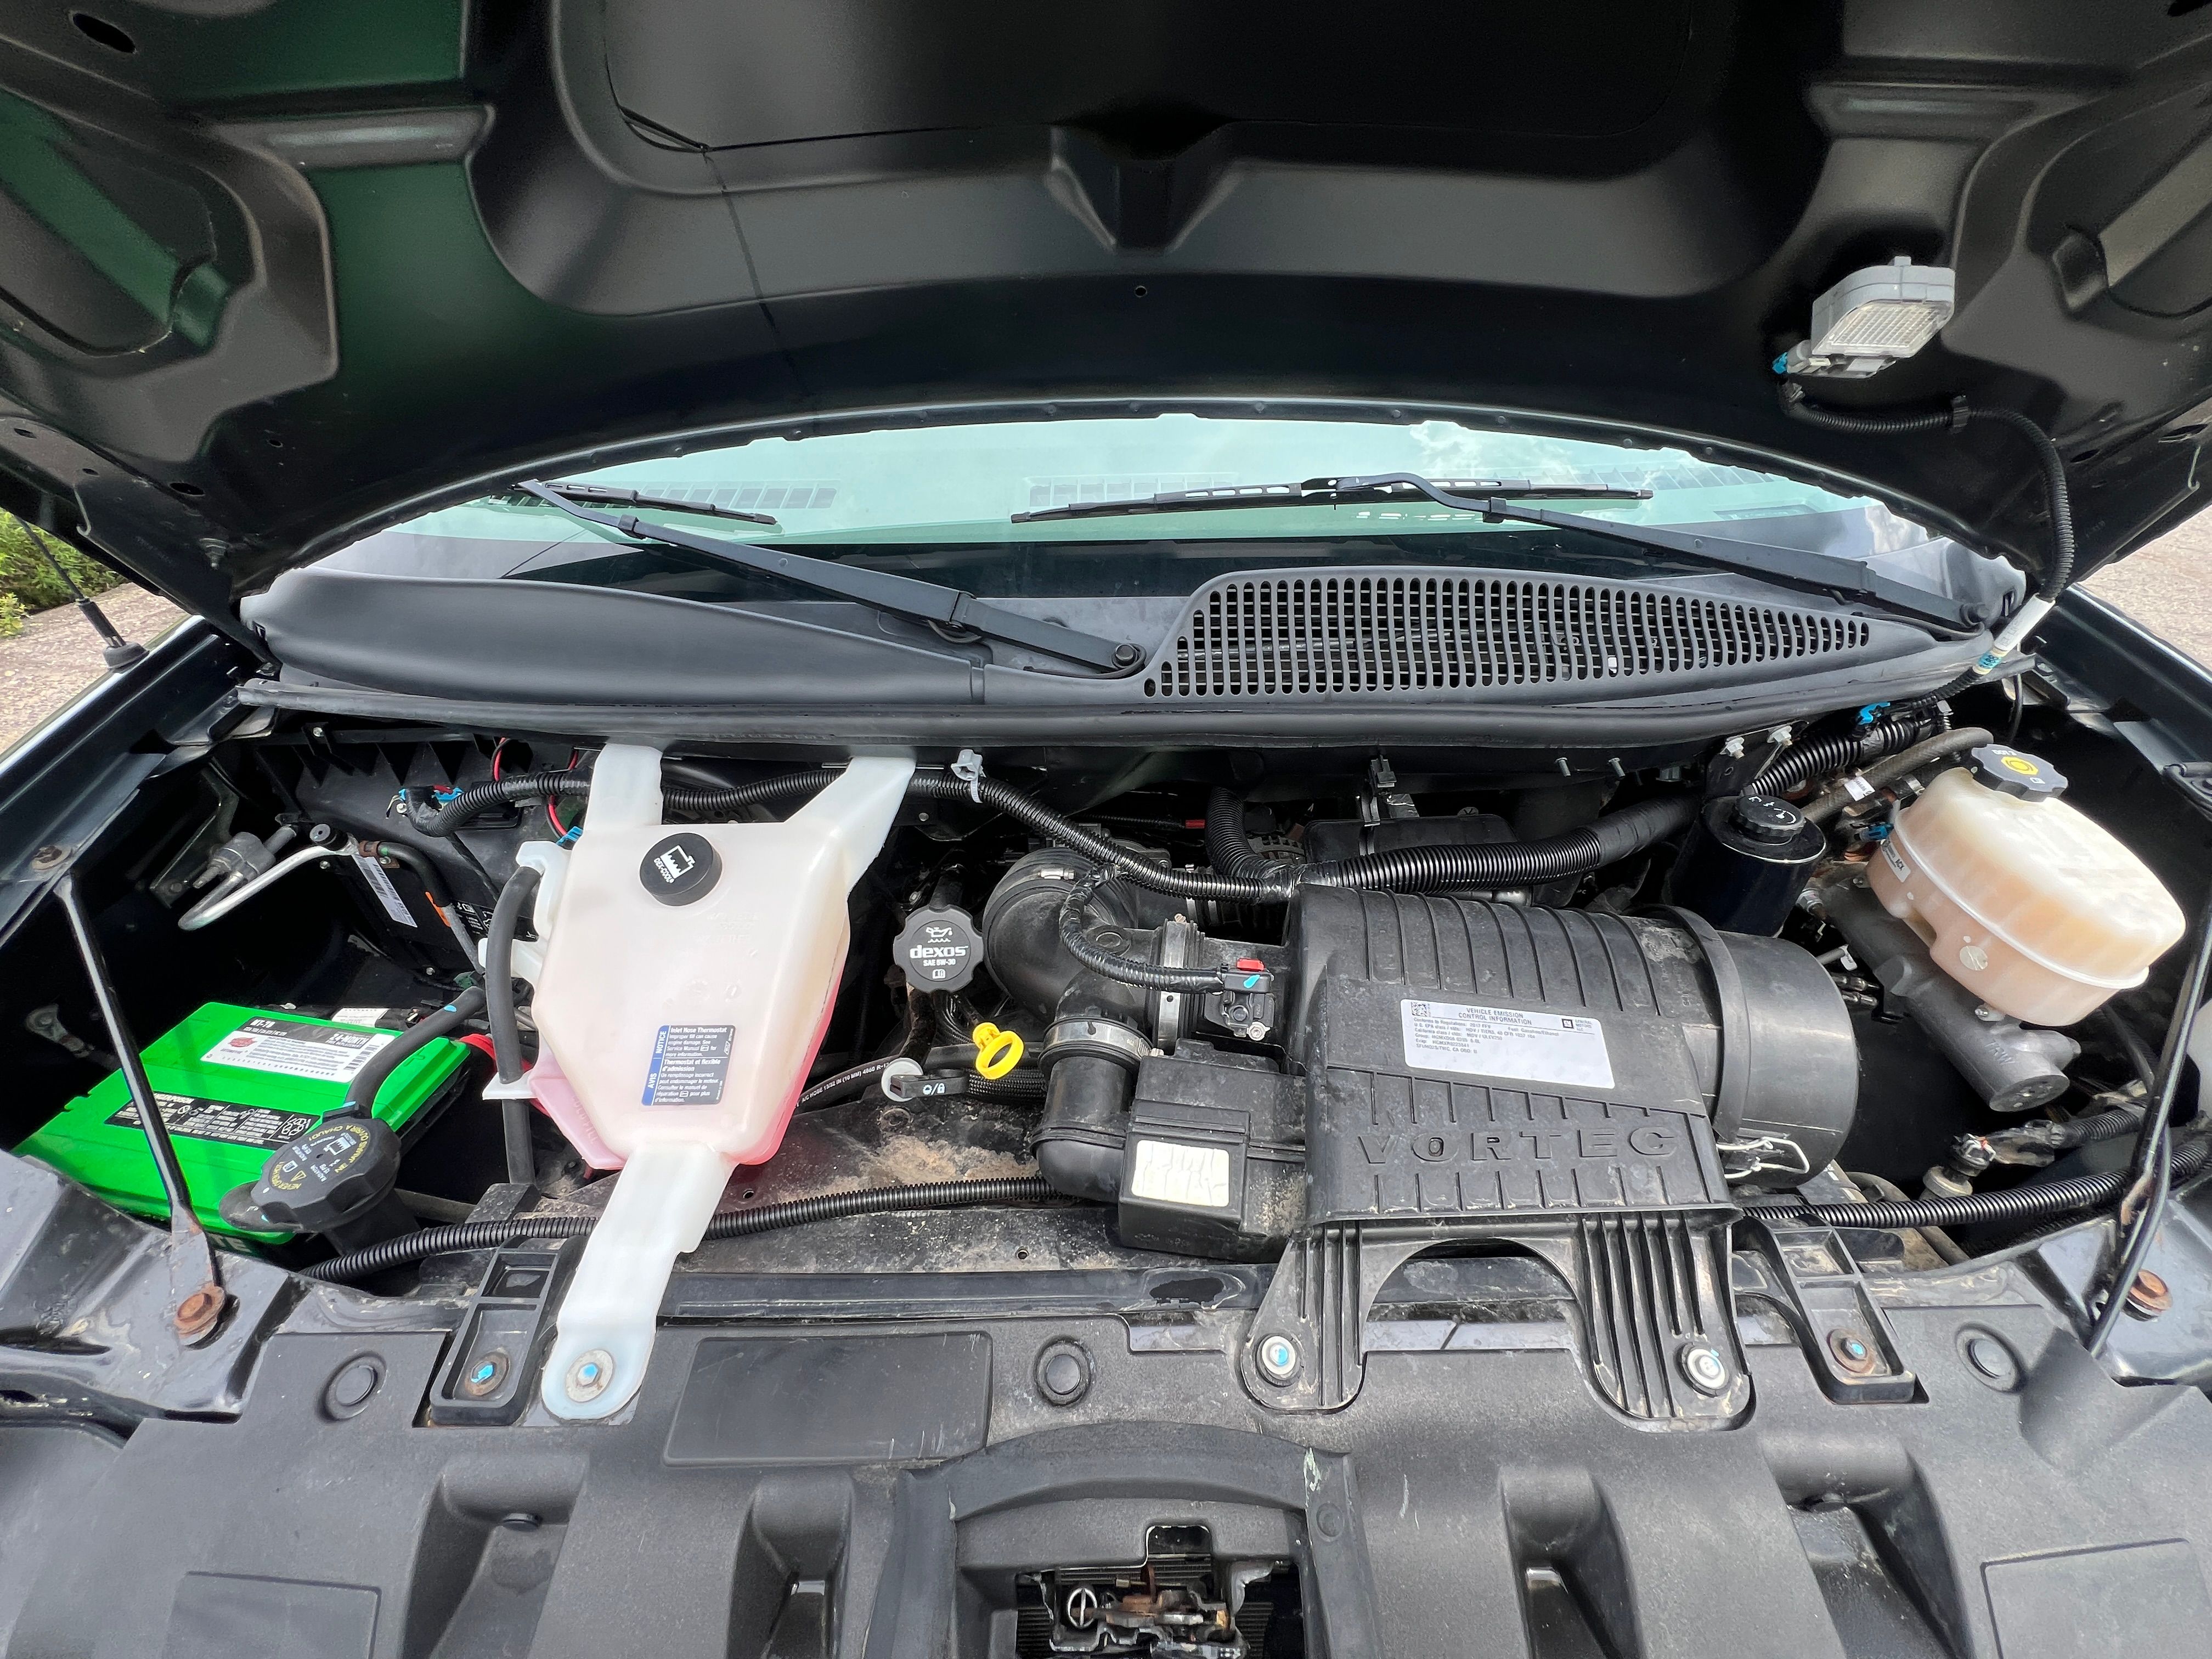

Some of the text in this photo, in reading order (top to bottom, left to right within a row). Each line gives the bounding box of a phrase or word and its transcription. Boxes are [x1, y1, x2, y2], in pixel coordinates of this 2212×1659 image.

[910, 945, 967, 958] dexos
[1489, 1016, 1532, 1025] INFORMATION
[1494, 1009, 1523, 1018] EMISSION
[656, 1031, 667, 1054] NOTICE
[647, 1073, 657, 1088] AVIS
[1357, 1126, 1677, 1164] VORTEC
